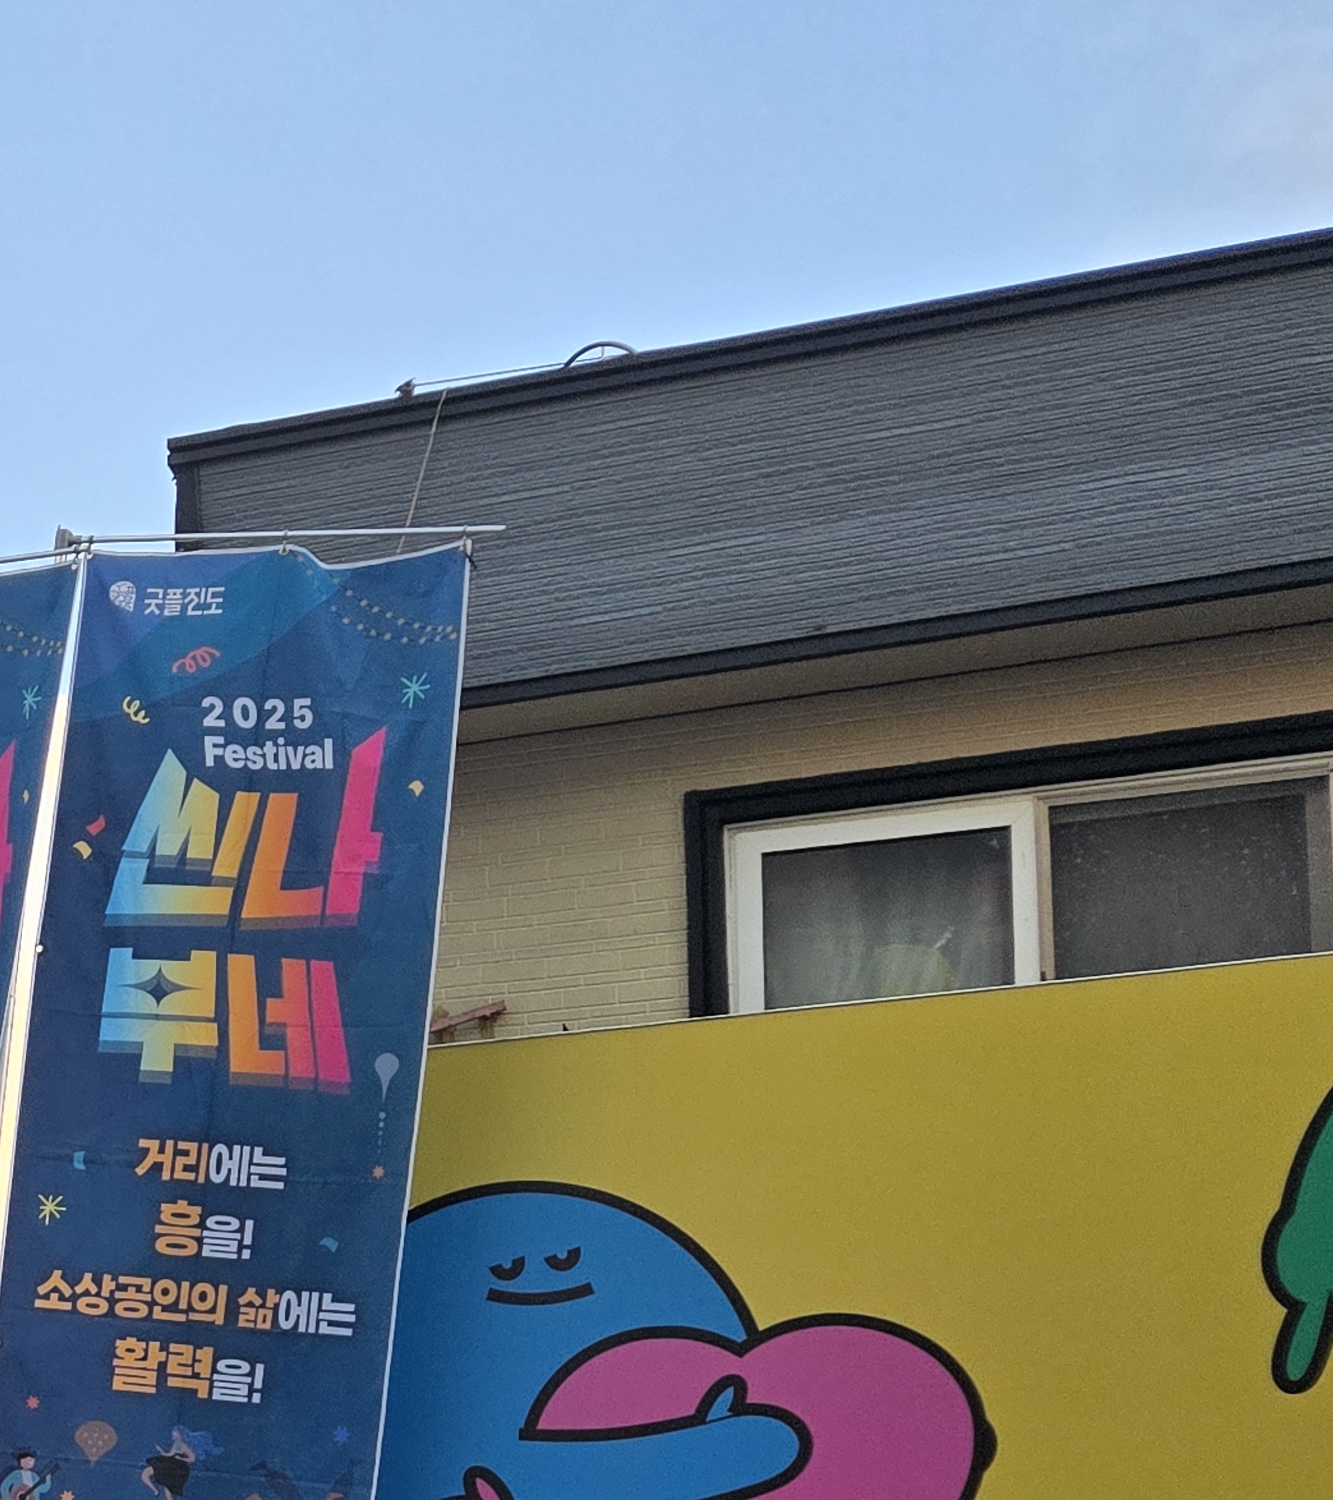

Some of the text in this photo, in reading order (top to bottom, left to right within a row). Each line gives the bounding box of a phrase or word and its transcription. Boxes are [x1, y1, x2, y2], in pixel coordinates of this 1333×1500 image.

[144, 587, 225, 616] 굿플진도
[201, 696, 314, 731] 2025
[204, 736, 333, 770] Festival
[98, 947, 352, 1094] 부네
[134, 1138, 288, 1189] 거리에는
[154, 1199, 254, 1260] 흥을!
[34, 1269, 356, 1336] 소상공인의 삶에는
[112, 1337, 265, 1404] 활력을!
